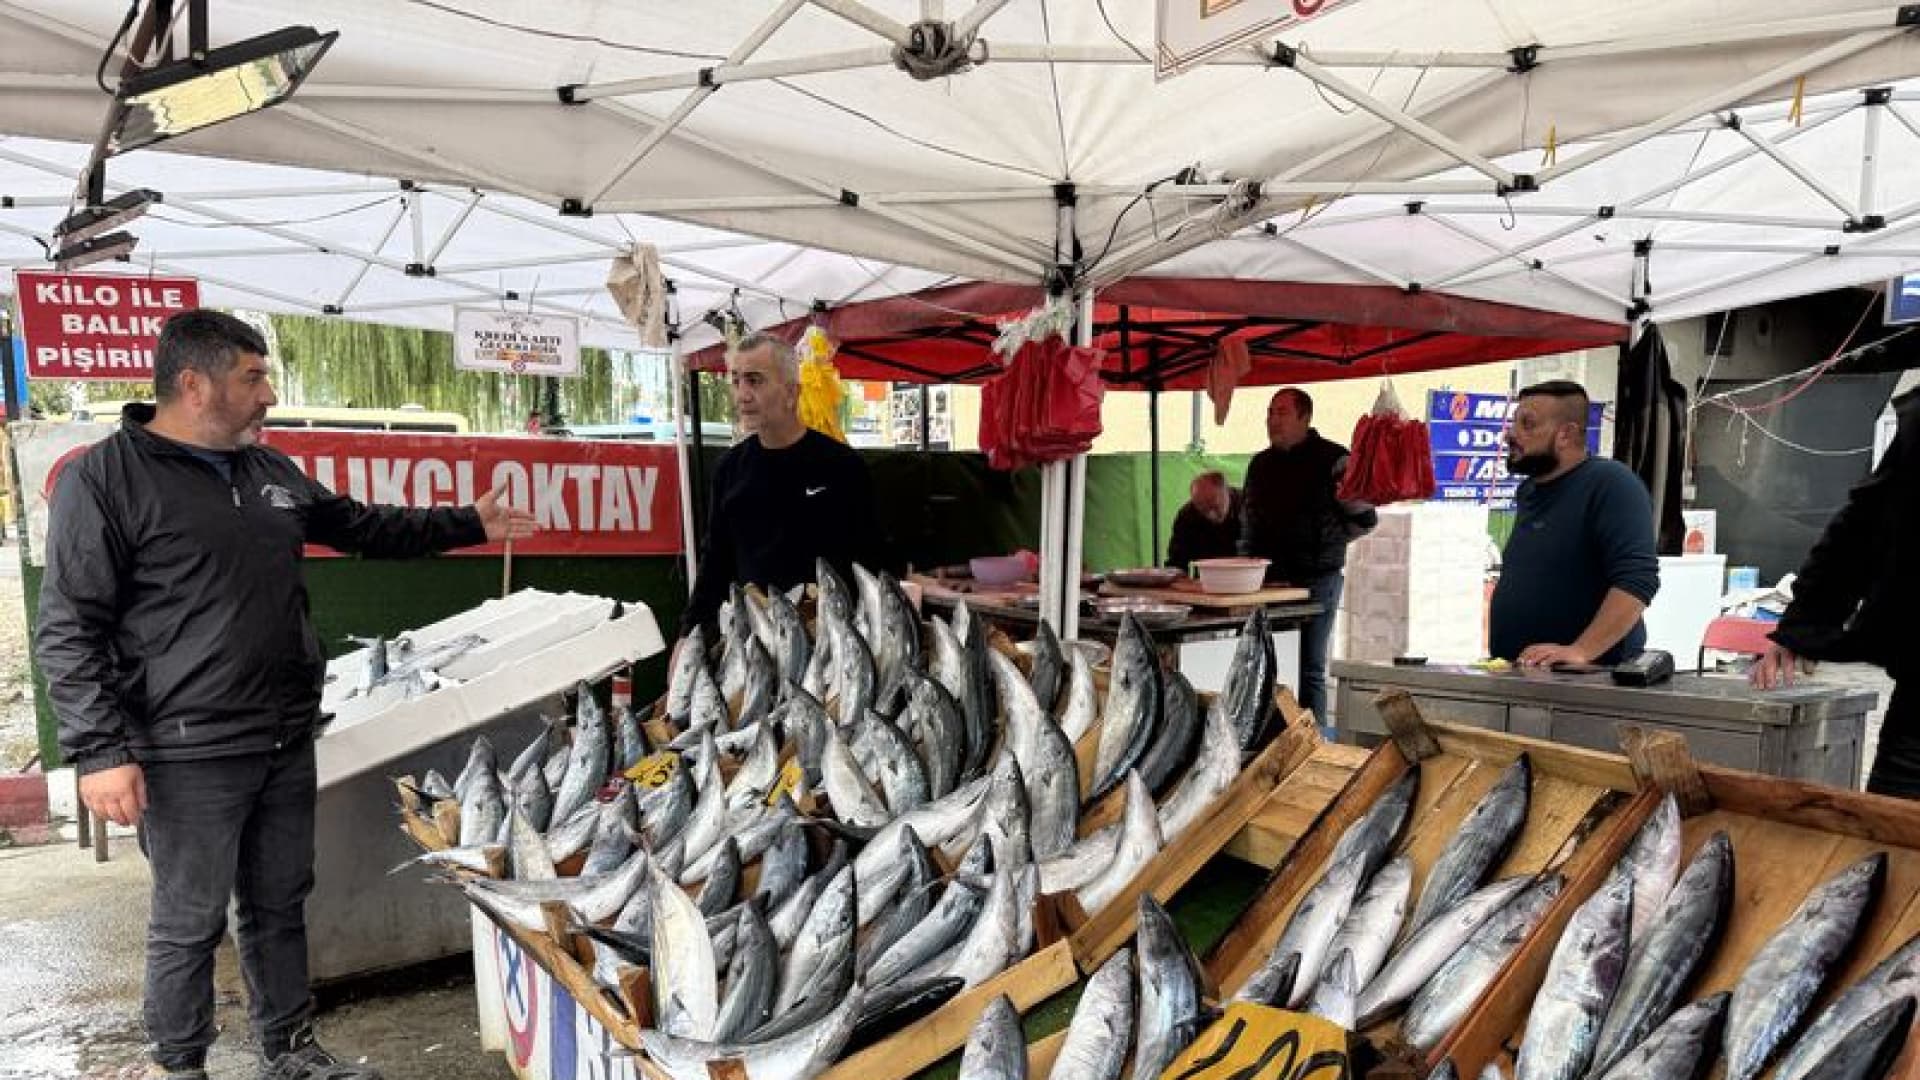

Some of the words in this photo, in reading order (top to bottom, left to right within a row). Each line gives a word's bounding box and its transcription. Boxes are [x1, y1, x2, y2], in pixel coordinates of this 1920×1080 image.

[35, 278, 120, 306] KİLO
[131, 280, 183, 308] İLE
[61, 313, 162, 337] BALIK
[491, 460, 658, 531] OKTAY
